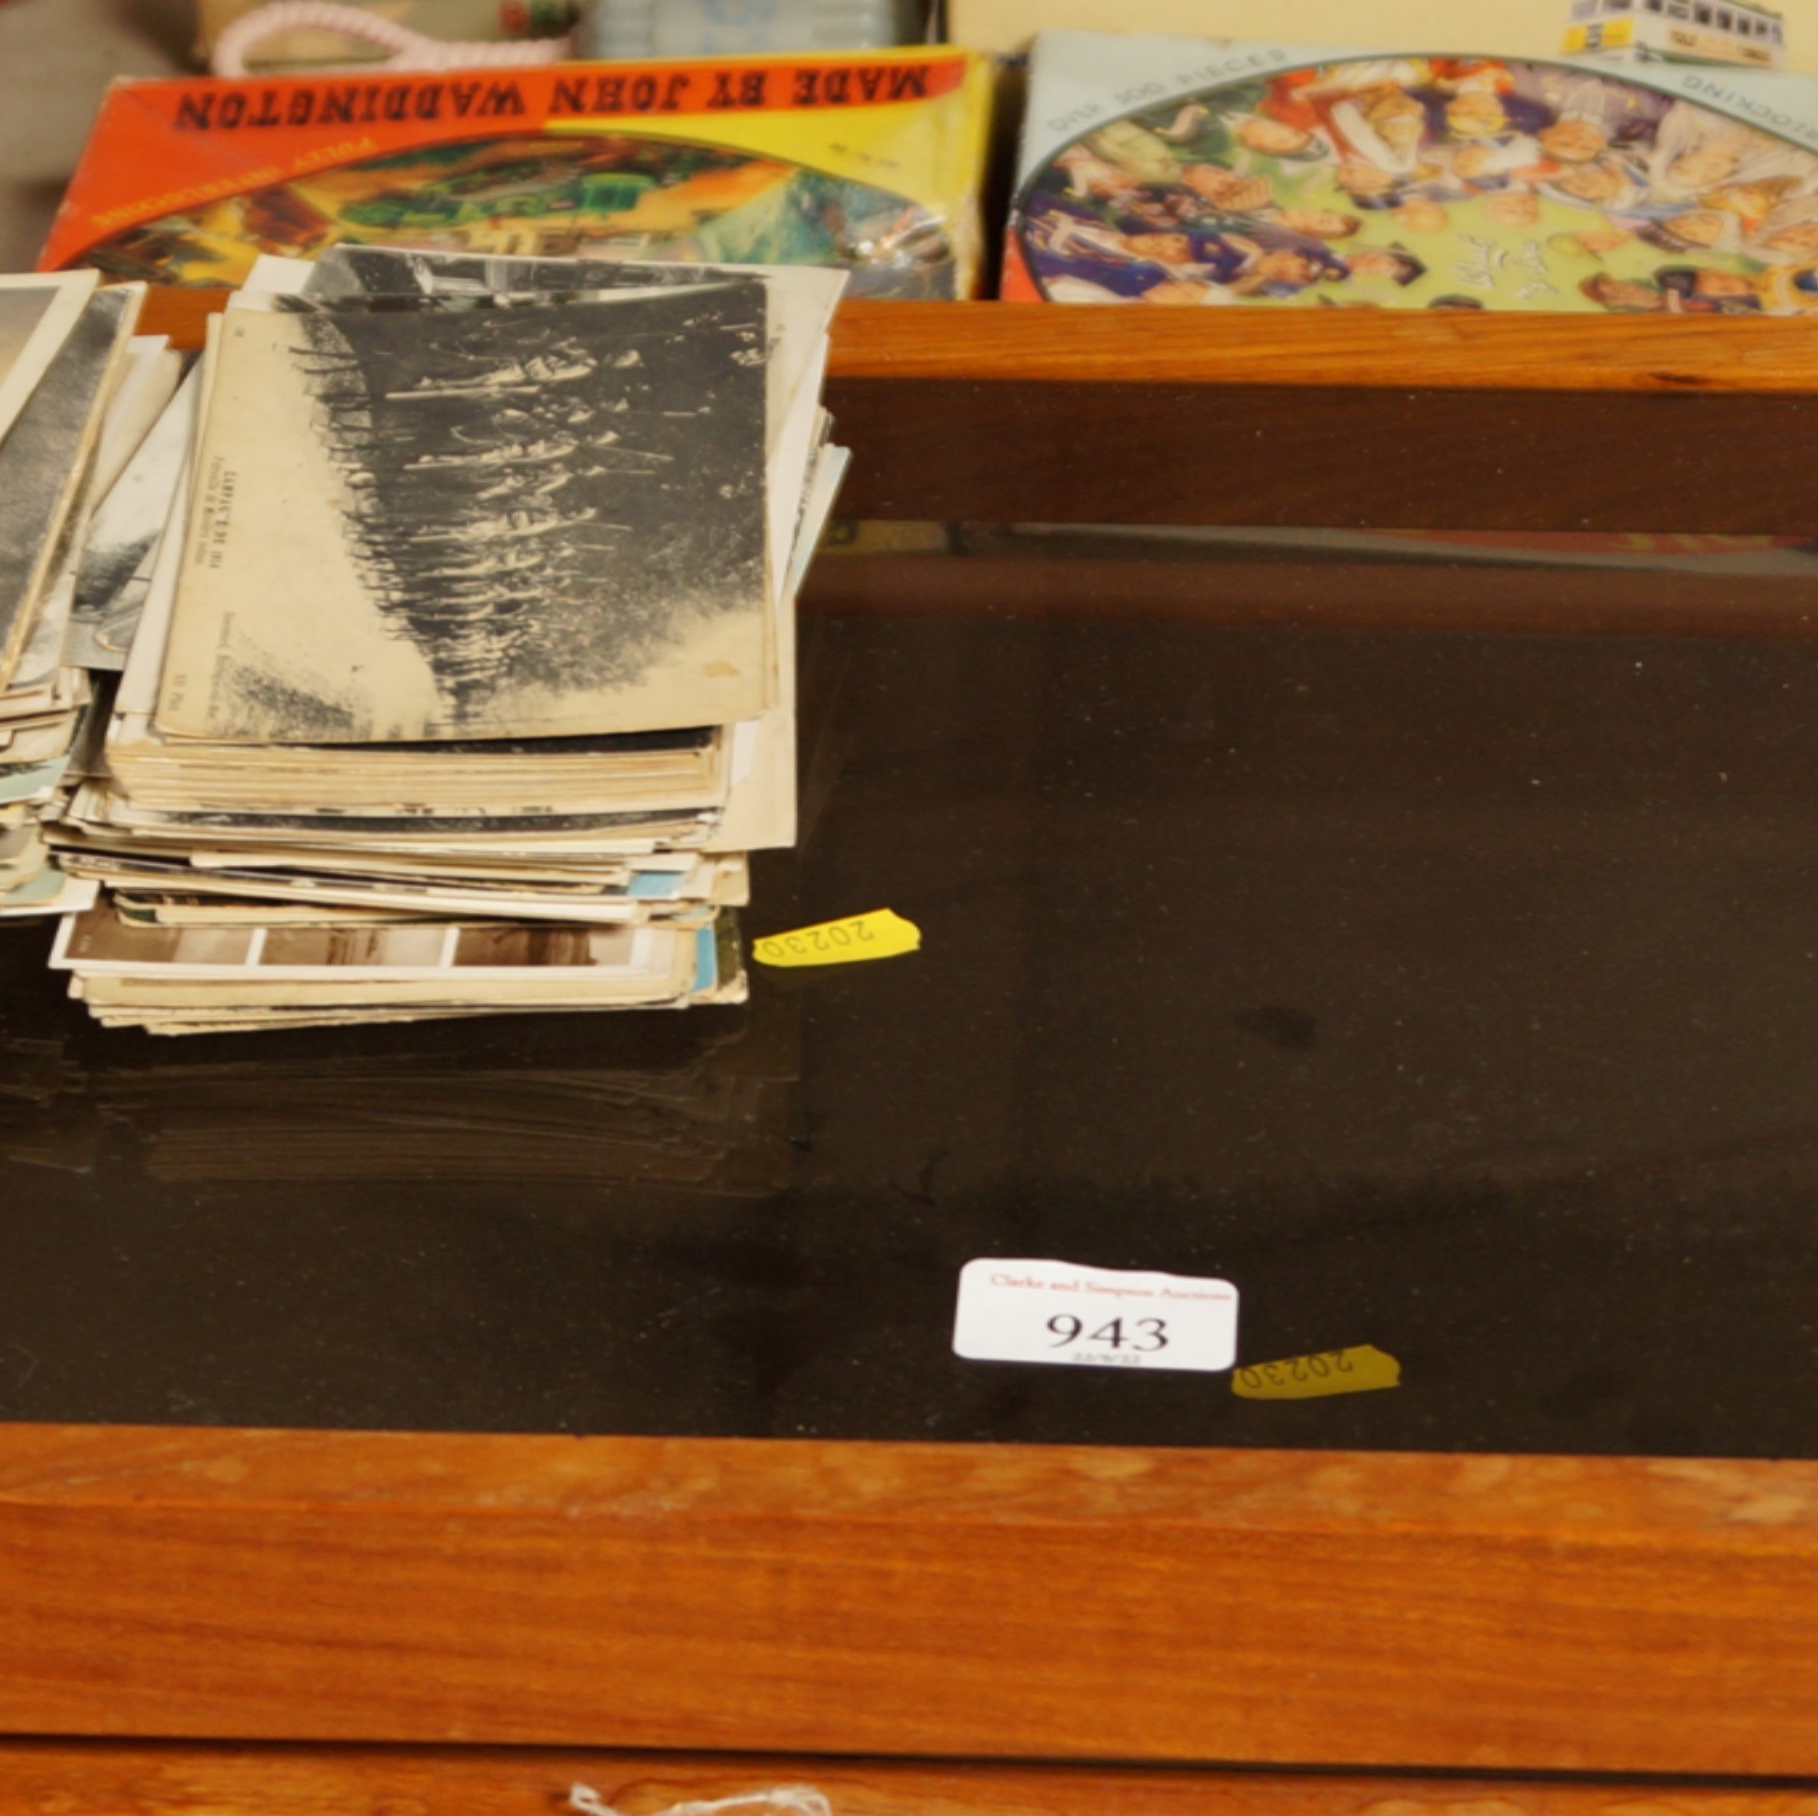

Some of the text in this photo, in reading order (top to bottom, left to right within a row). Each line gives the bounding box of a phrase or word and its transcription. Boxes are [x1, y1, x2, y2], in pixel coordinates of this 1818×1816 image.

[172, 63, 931, 132] MADE BY JOHN WADDINGTON
[215, 469, 239, 527] CAMPAGE
[761, 919, 875, 959] 20230
[989, 1273, 1232, 1302] Clarke and Simpson Auctions
[1045, 1312, 1169, 1352] 943
[1238, 1348, 1355, 1390] 20230
